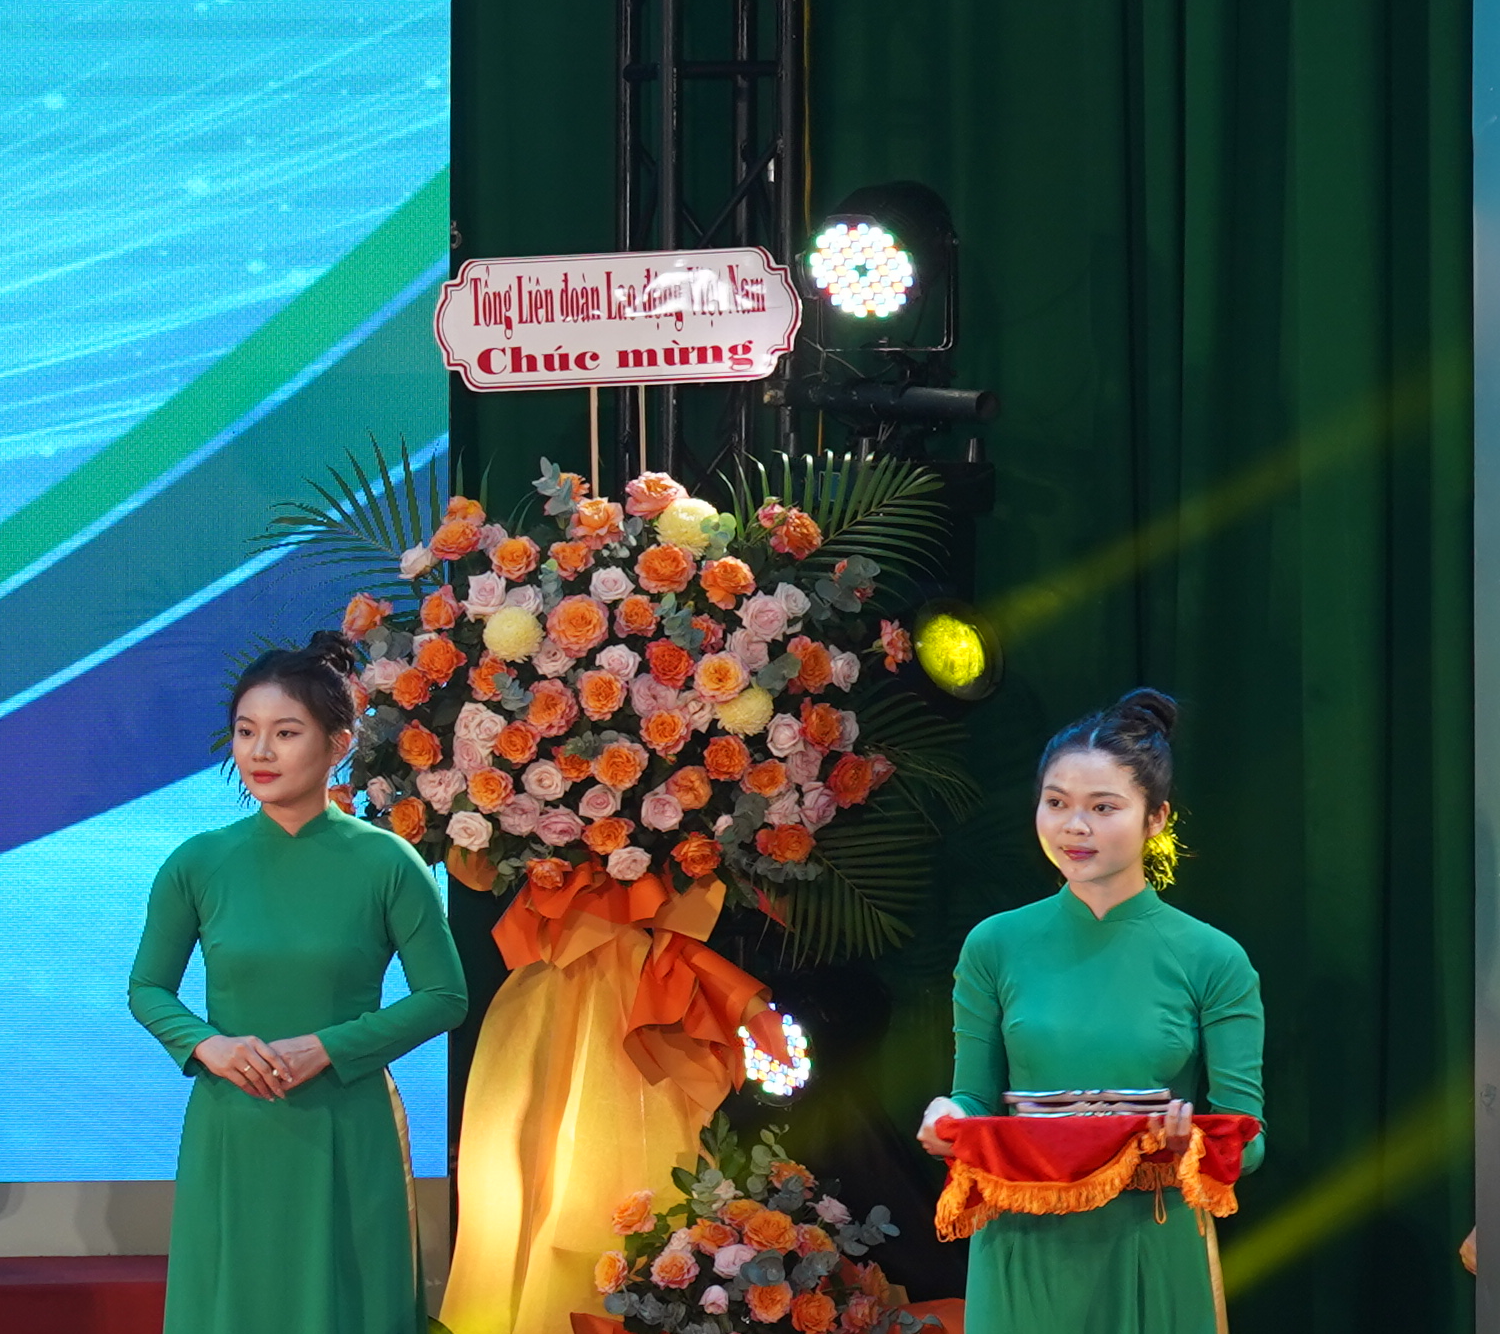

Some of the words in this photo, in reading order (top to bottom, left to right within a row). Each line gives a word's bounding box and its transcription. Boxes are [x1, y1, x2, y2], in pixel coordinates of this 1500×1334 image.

[470, 265, 513, 340] Tổng
[516, 275, 555, 325] Liên
[560, 272, 601, 323] đoàn
[605, 271, 637, 321] Lao
[727, 264, 767, 315] Nam
[477, 345, 601, 375] Chúc
[616, 339, 754, 372] mừng
